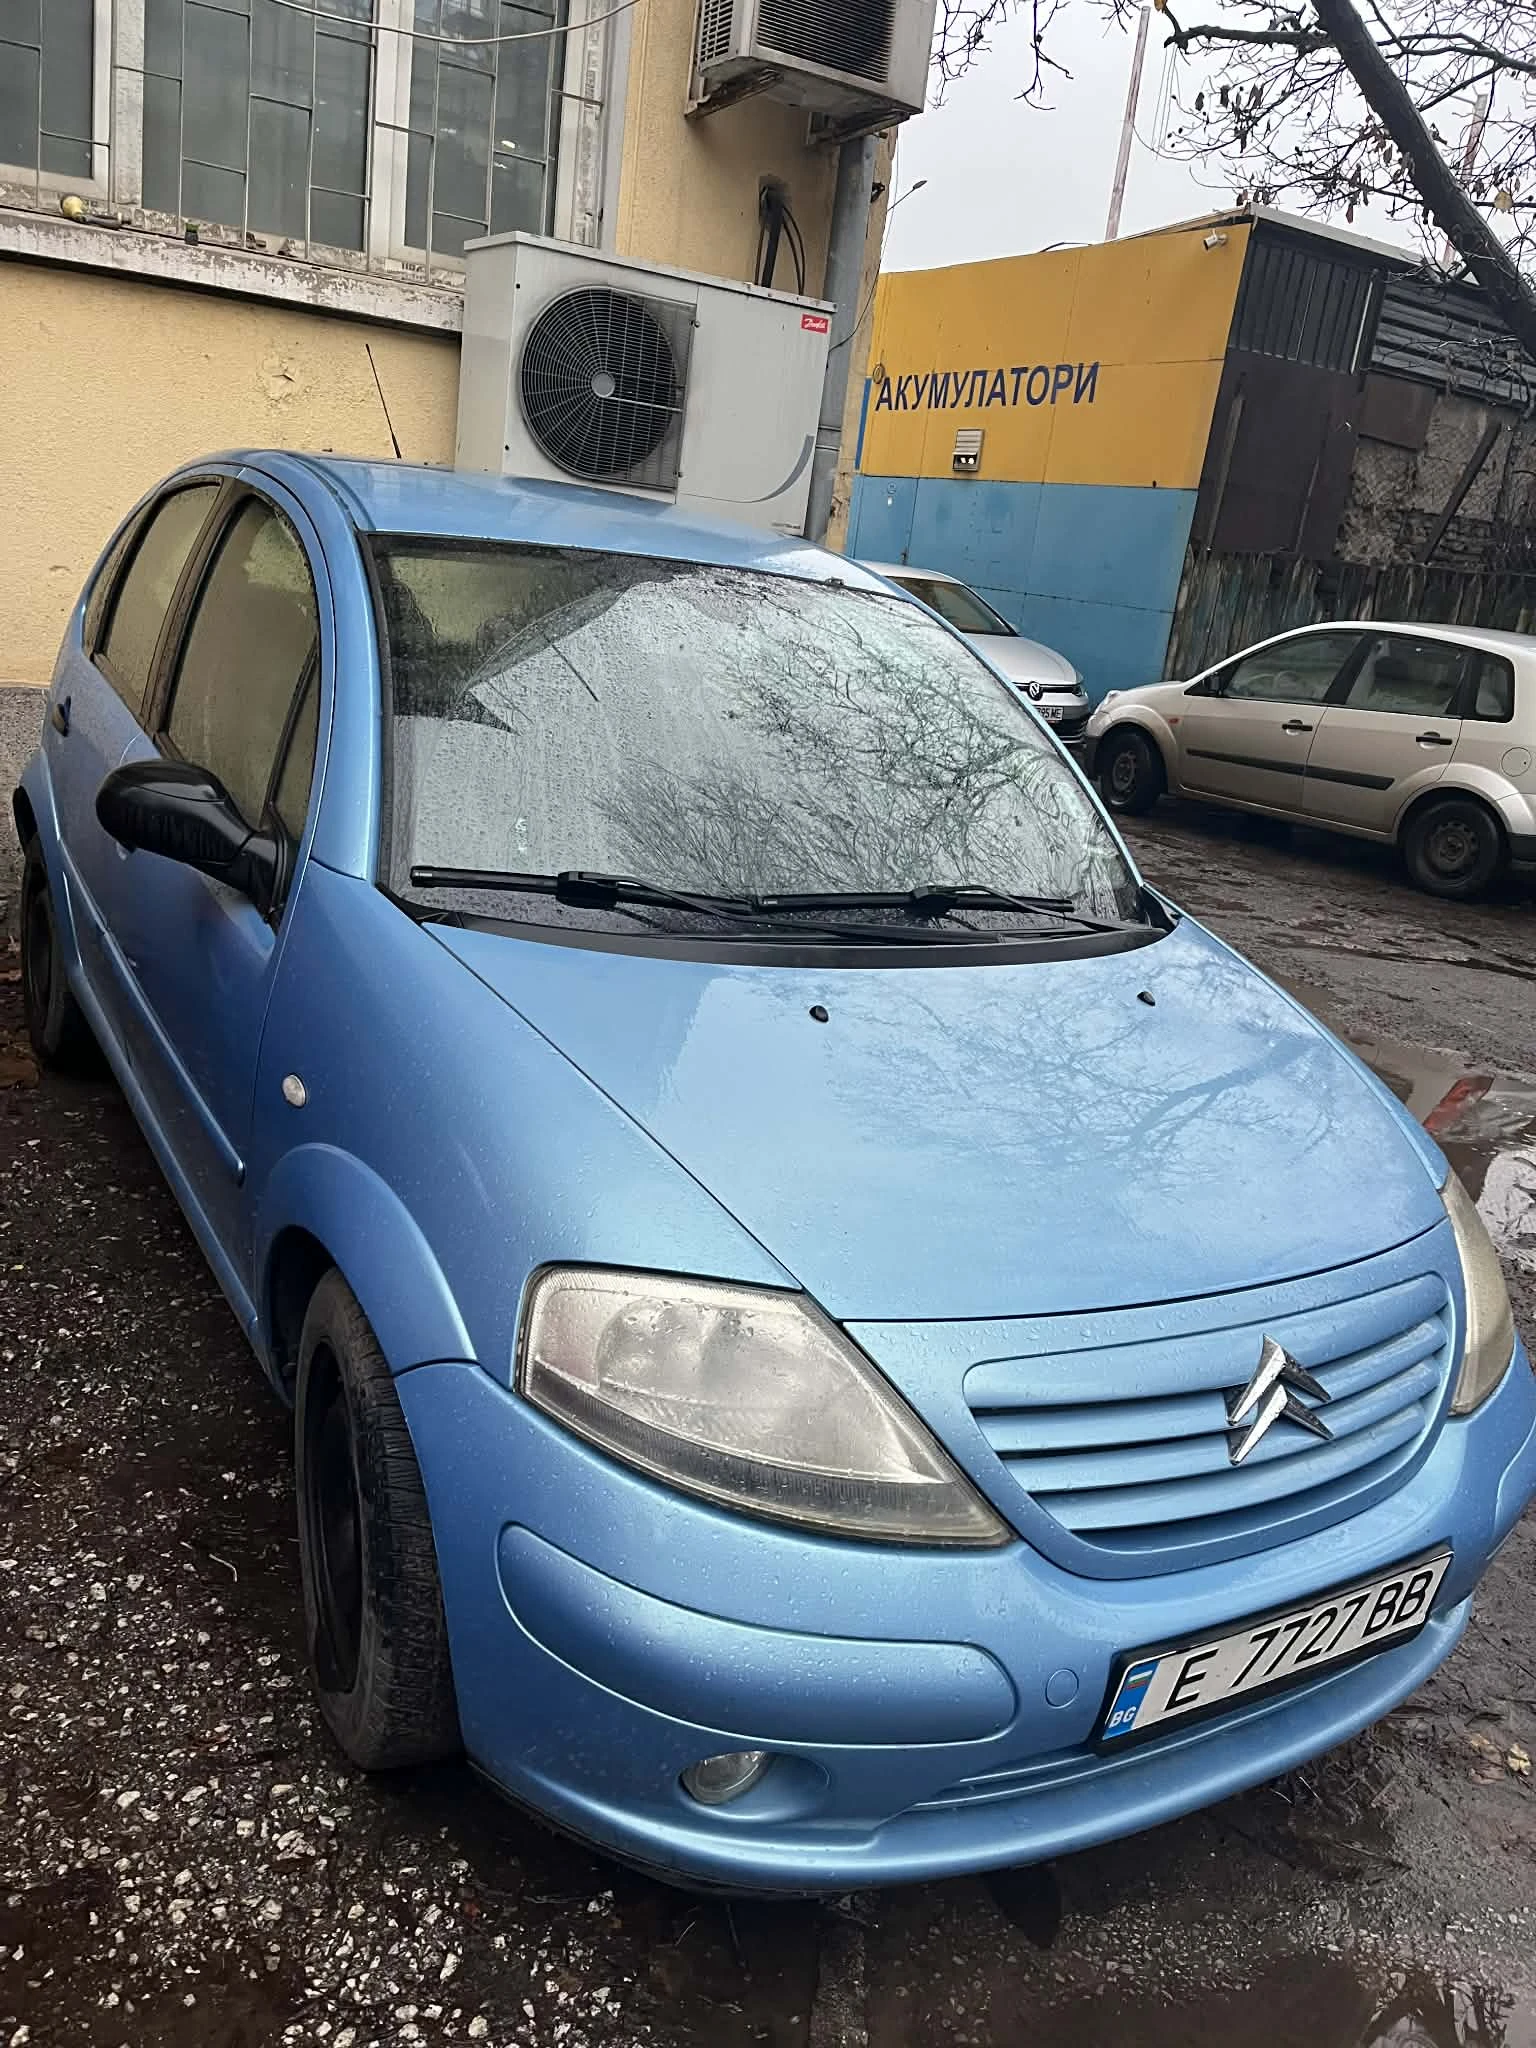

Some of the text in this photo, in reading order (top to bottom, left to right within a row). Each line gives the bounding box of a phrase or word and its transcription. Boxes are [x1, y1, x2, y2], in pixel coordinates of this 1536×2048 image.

[875, 361, 1100, 411] АКУМУЛАТОРИ
[1163, 1569, 1434, 1711] E 7727 BB
[1109, 1706, 1137, 1729] BG
